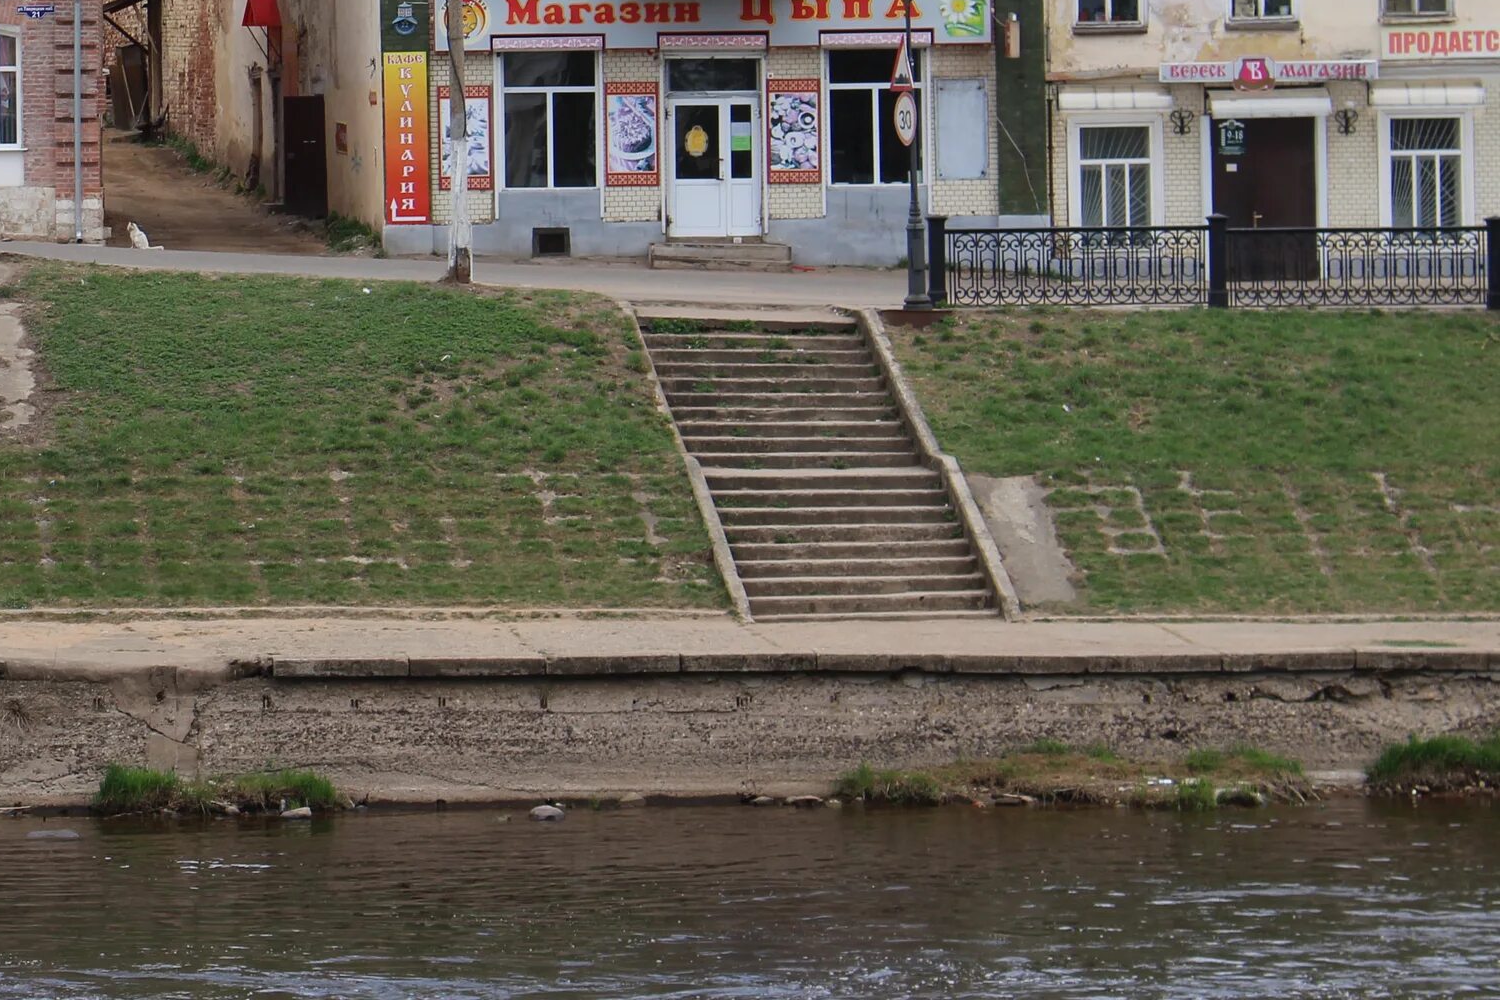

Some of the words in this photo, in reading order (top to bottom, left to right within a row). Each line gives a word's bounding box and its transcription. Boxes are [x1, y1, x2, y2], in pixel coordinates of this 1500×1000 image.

[1388, 30, 1500, 56] ПРОДАЕТС
[387, 55, 423, 64] КАФЕ
[1170, 64, 1226, 77] ВЕРЕСК
[1279, 63, 1367, 80] МАГАЗИН
[899, 109, 912, 130] 30
[400, 68, 415, 210] КУЛИНАРИЯ
